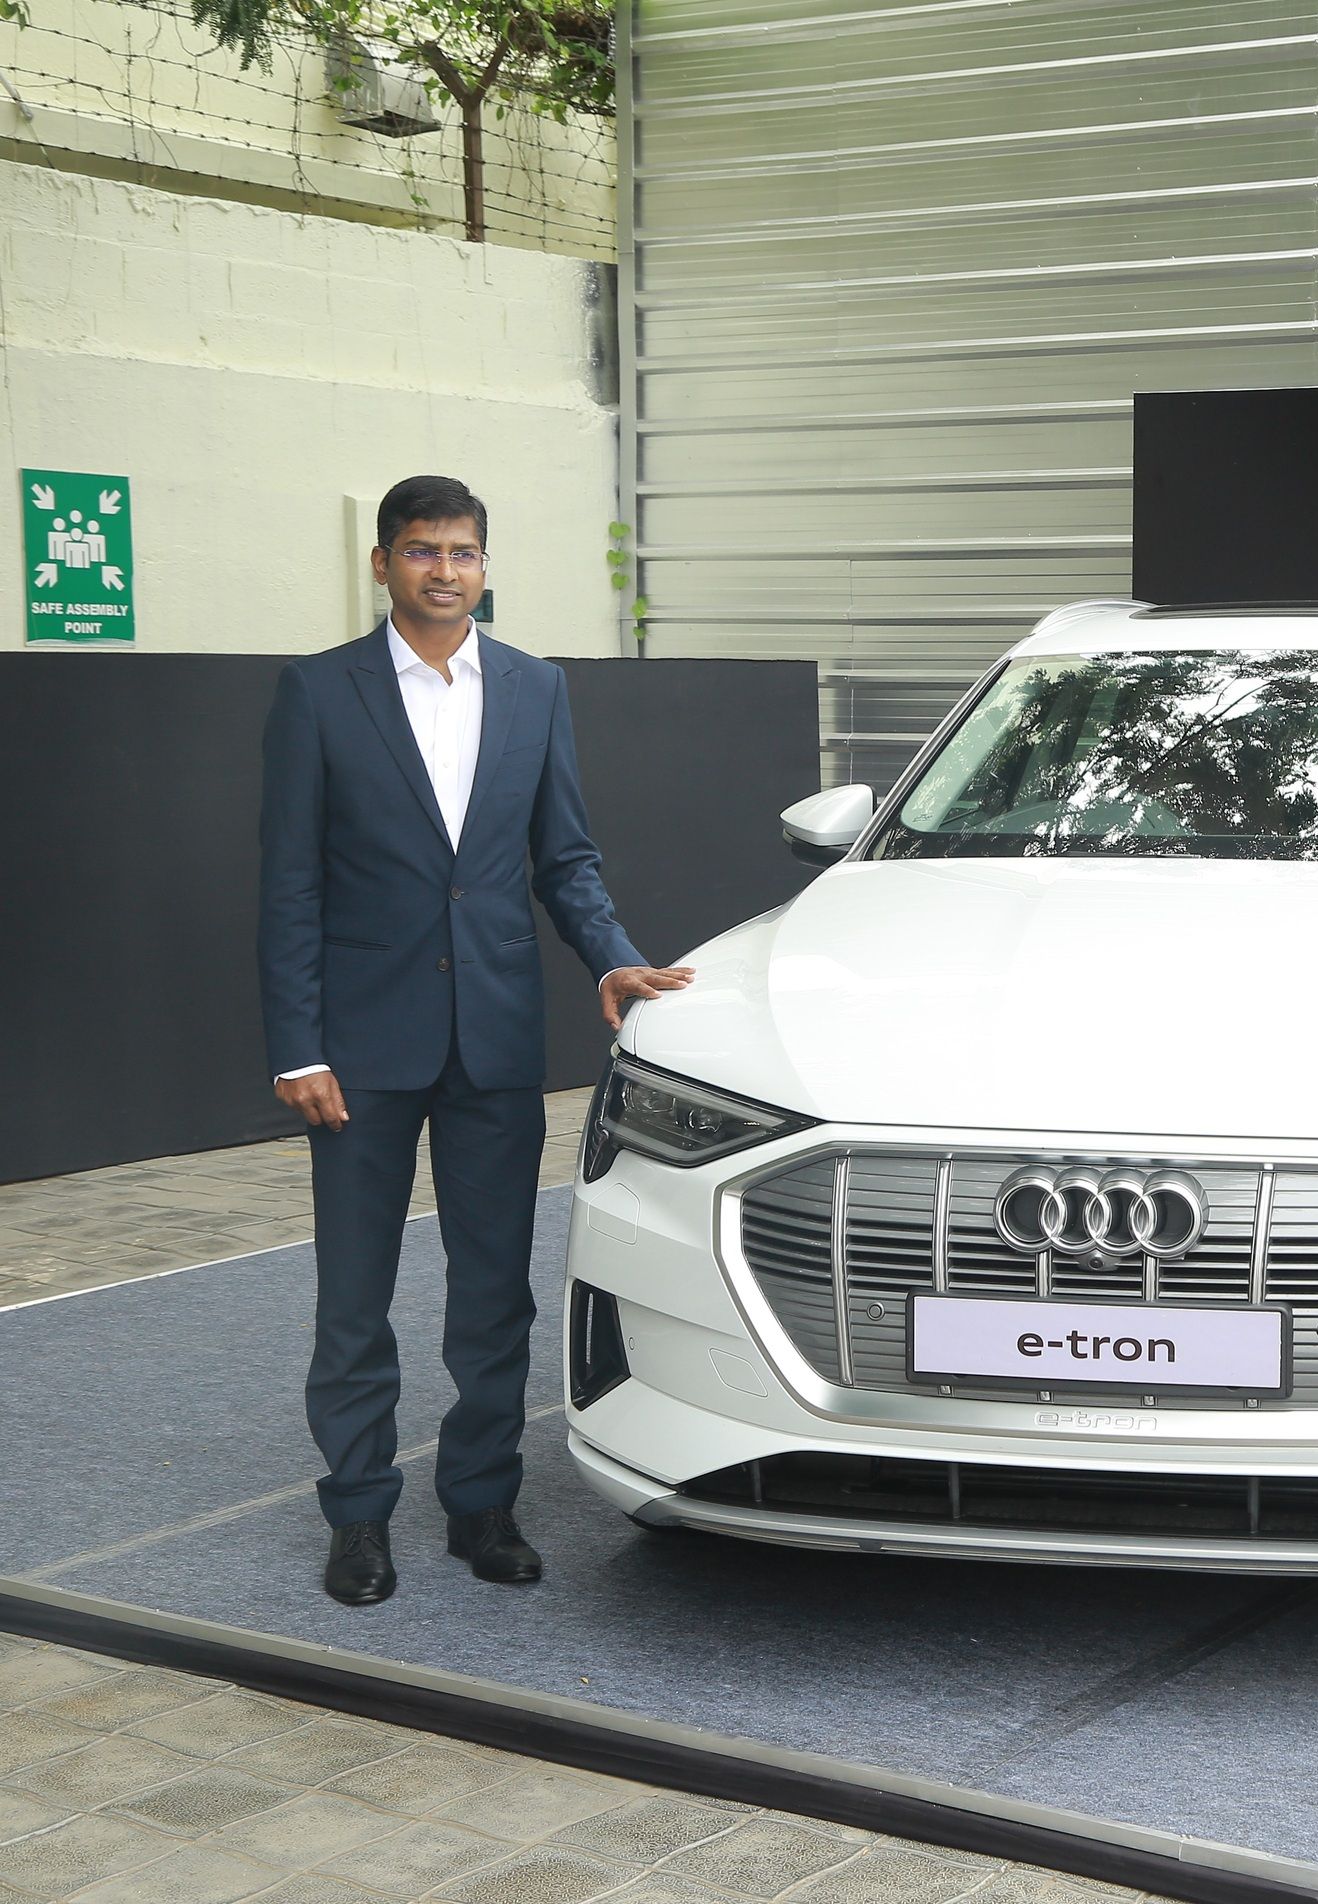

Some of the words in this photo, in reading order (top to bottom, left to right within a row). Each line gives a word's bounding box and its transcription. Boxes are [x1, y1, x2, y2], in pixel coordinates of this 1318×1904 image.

[31, 602, 64, 615] SAFE
[66, 604, 128, 617] ASSEMBLY
[64, 622, 102, 634] POINT
[1017, 1330, 1176, 1363] e-tron
[1034, 1410, 1158, 1430] e-tron
